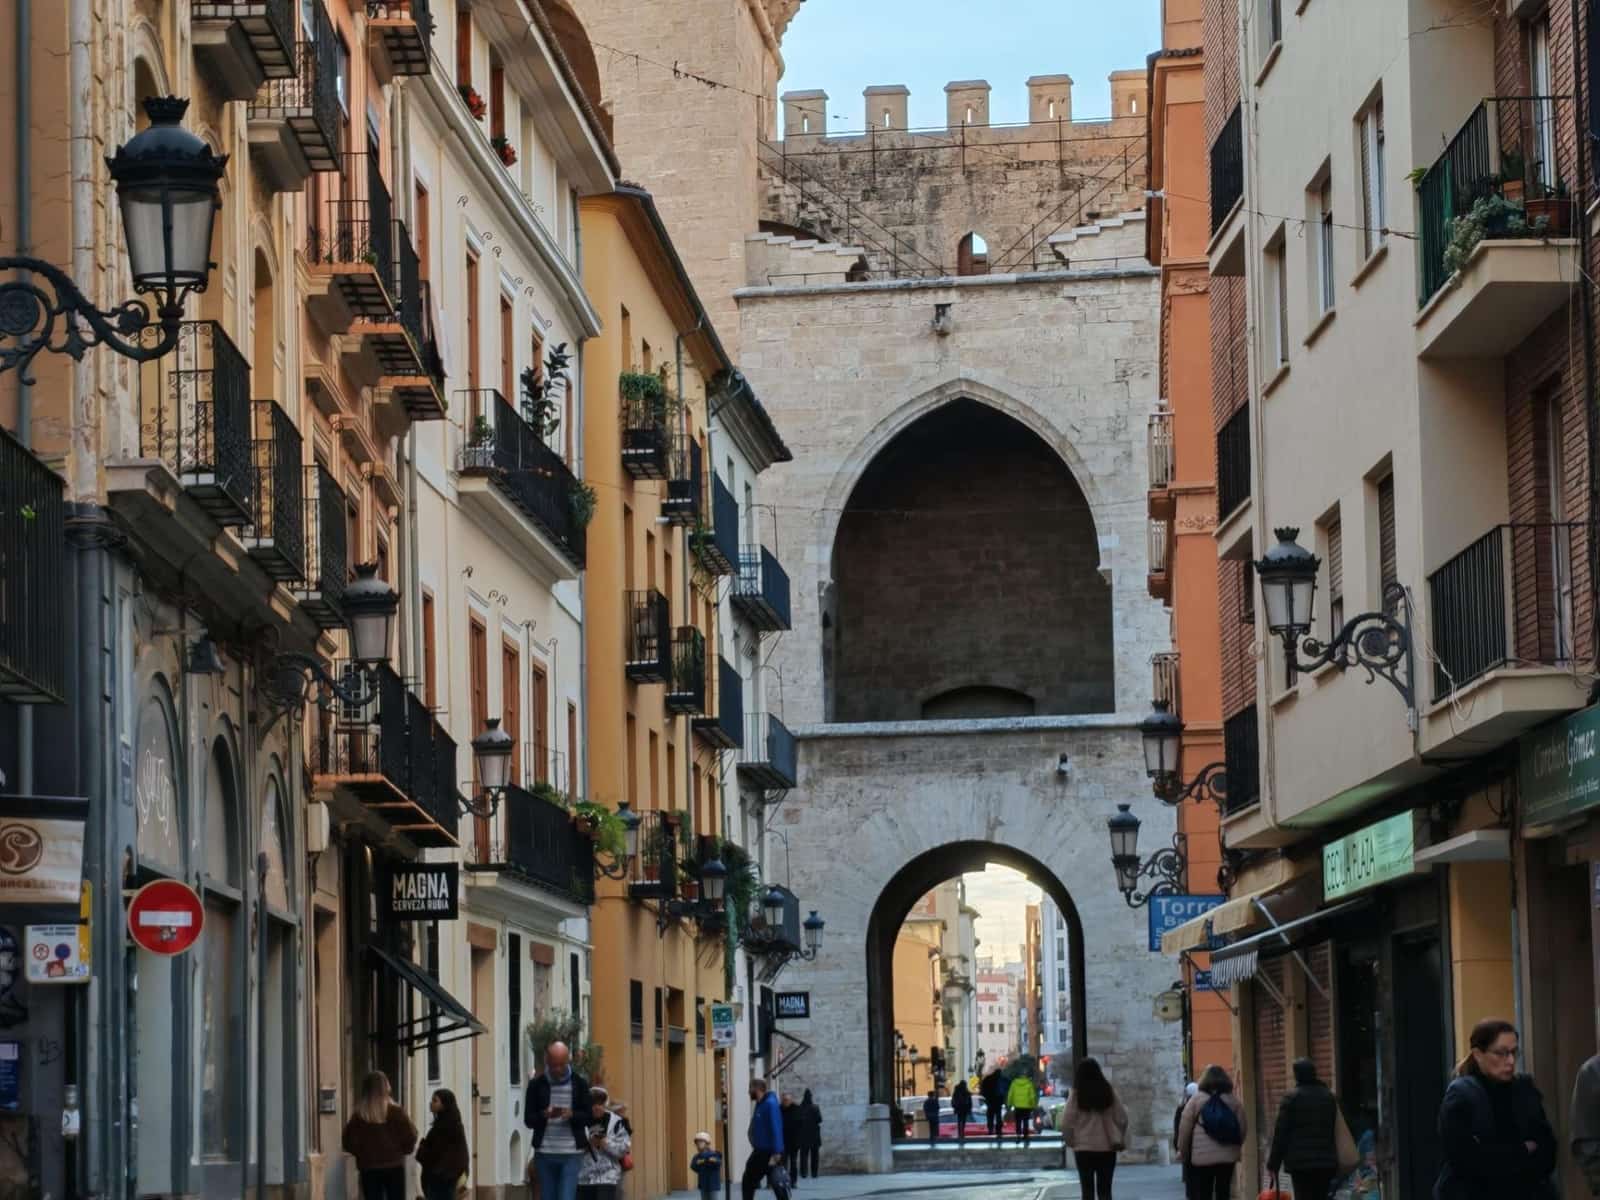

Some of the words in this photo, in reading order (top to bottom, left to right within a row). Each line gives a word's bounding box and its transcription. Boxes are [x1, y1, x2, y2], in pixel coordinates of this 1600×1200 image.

[393, 872, 449, 899] MAGNA
[392, 900, 425, 912] CERVEZA
[779, 995, 806, 1009] MAGNA
